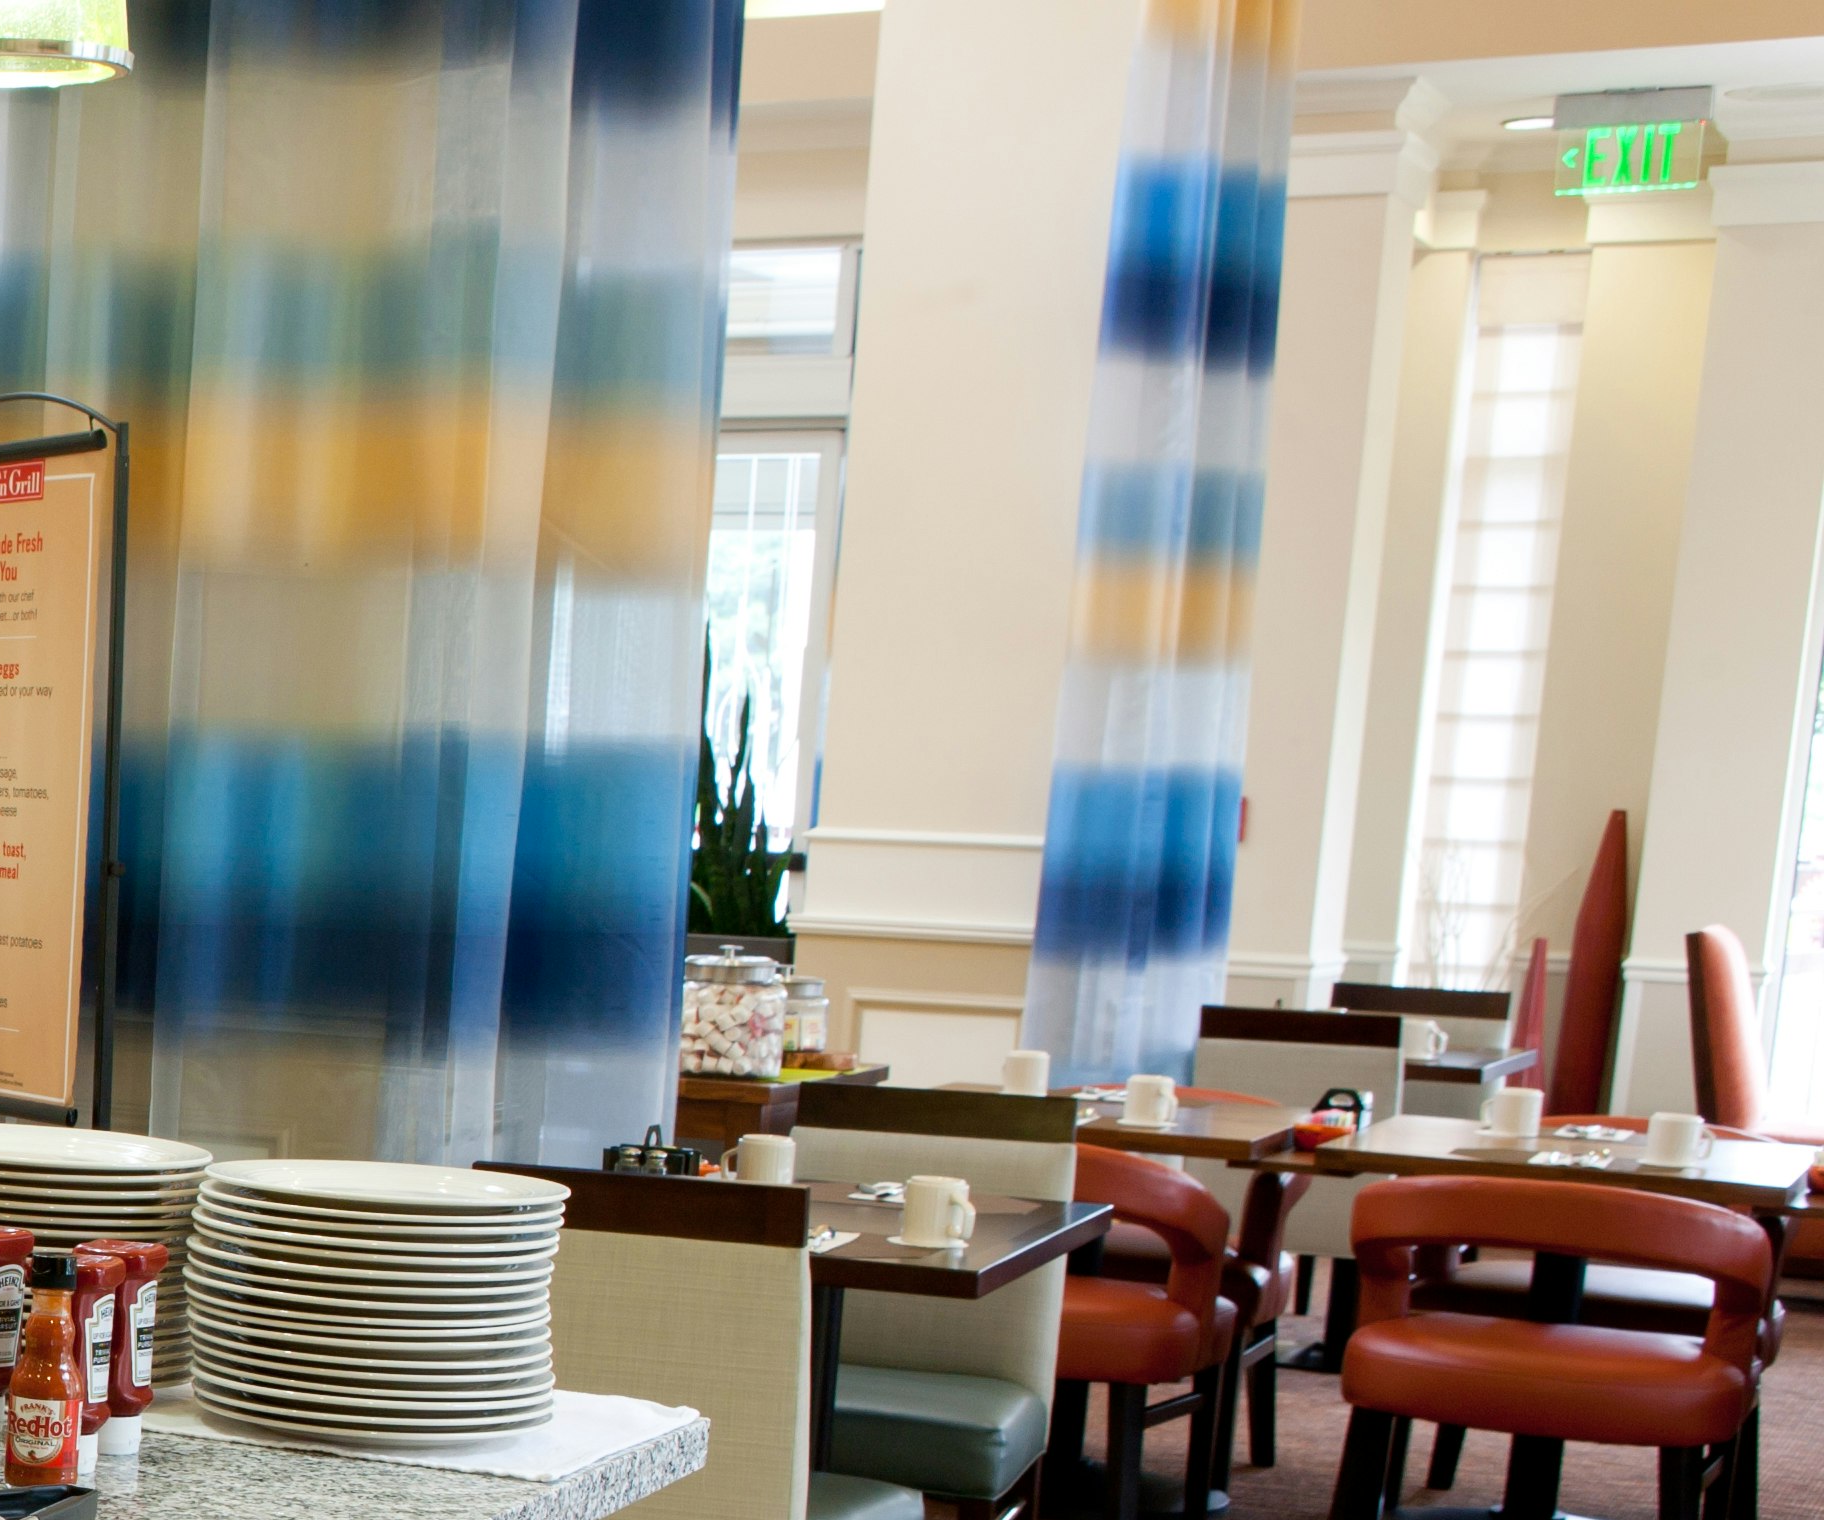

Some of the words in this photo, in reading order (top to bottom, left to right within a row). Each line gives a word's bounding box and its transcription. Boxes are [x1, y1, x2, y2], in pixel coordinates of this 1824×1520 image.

[1583, 122, 1681, 186] EXIT
[9, 469, 40, 495] Grill
[16, 531, 43, 553] Fresh
[0, 561, 17, 581] You
[8, 593, 19, 602] our
[21, 589, 34, 601] chef
[10, 687, 17, 696] or
[19, 686, 33, 698] your
[36, 686, 52, 698] way
[13, 786, 49, 800] tomatoes,
[3, 840, 26, 860] toast,
[10, 935, 43, 949] potatoes
[20, 1403, 54, 1415] FRANK'S
[9, 1410, 72, 1437] RedHot
[16, 1435, 55, 1446] ORIGINAL
